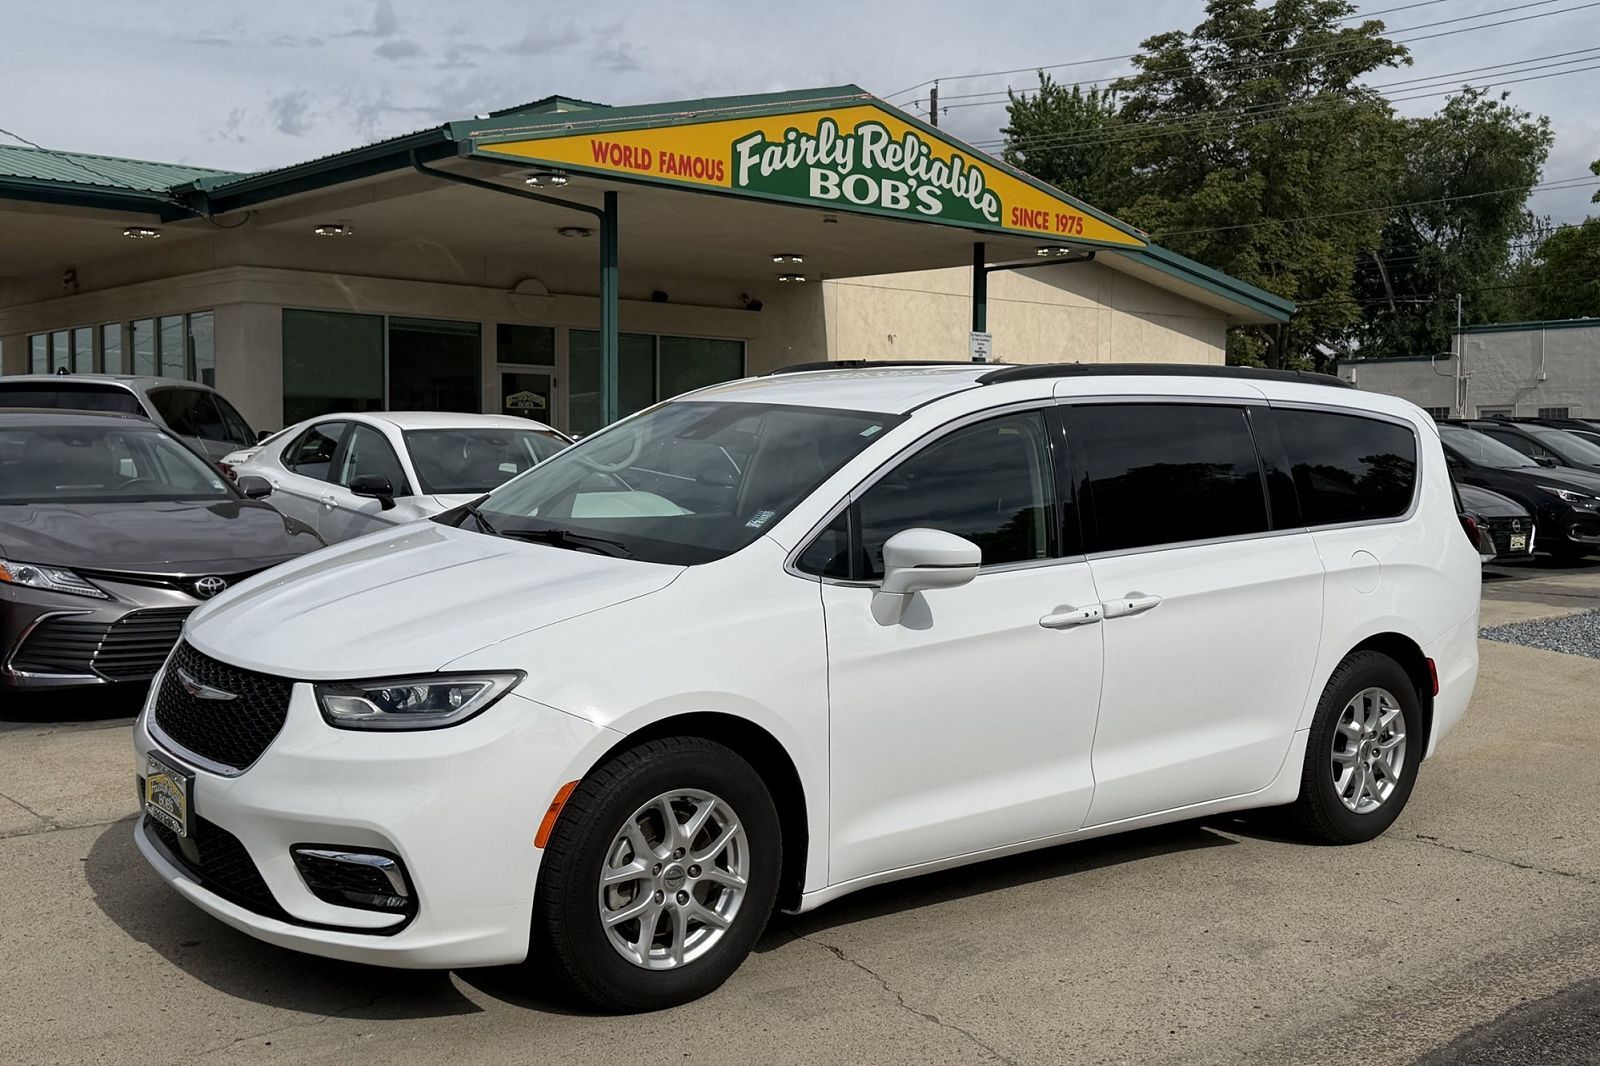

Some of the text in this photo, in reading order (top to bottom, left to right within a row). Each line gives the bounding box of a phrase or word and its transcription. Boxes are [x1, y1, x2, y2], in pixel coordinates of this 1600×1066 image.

[591, 140, 724, 182] WORLD FAMOUS
[736, 121, 999, 222] Fairly Reliable
[809, 167, 943, 215] BOB'S
[1011, 206, 1083, 235] SINCE 1975
